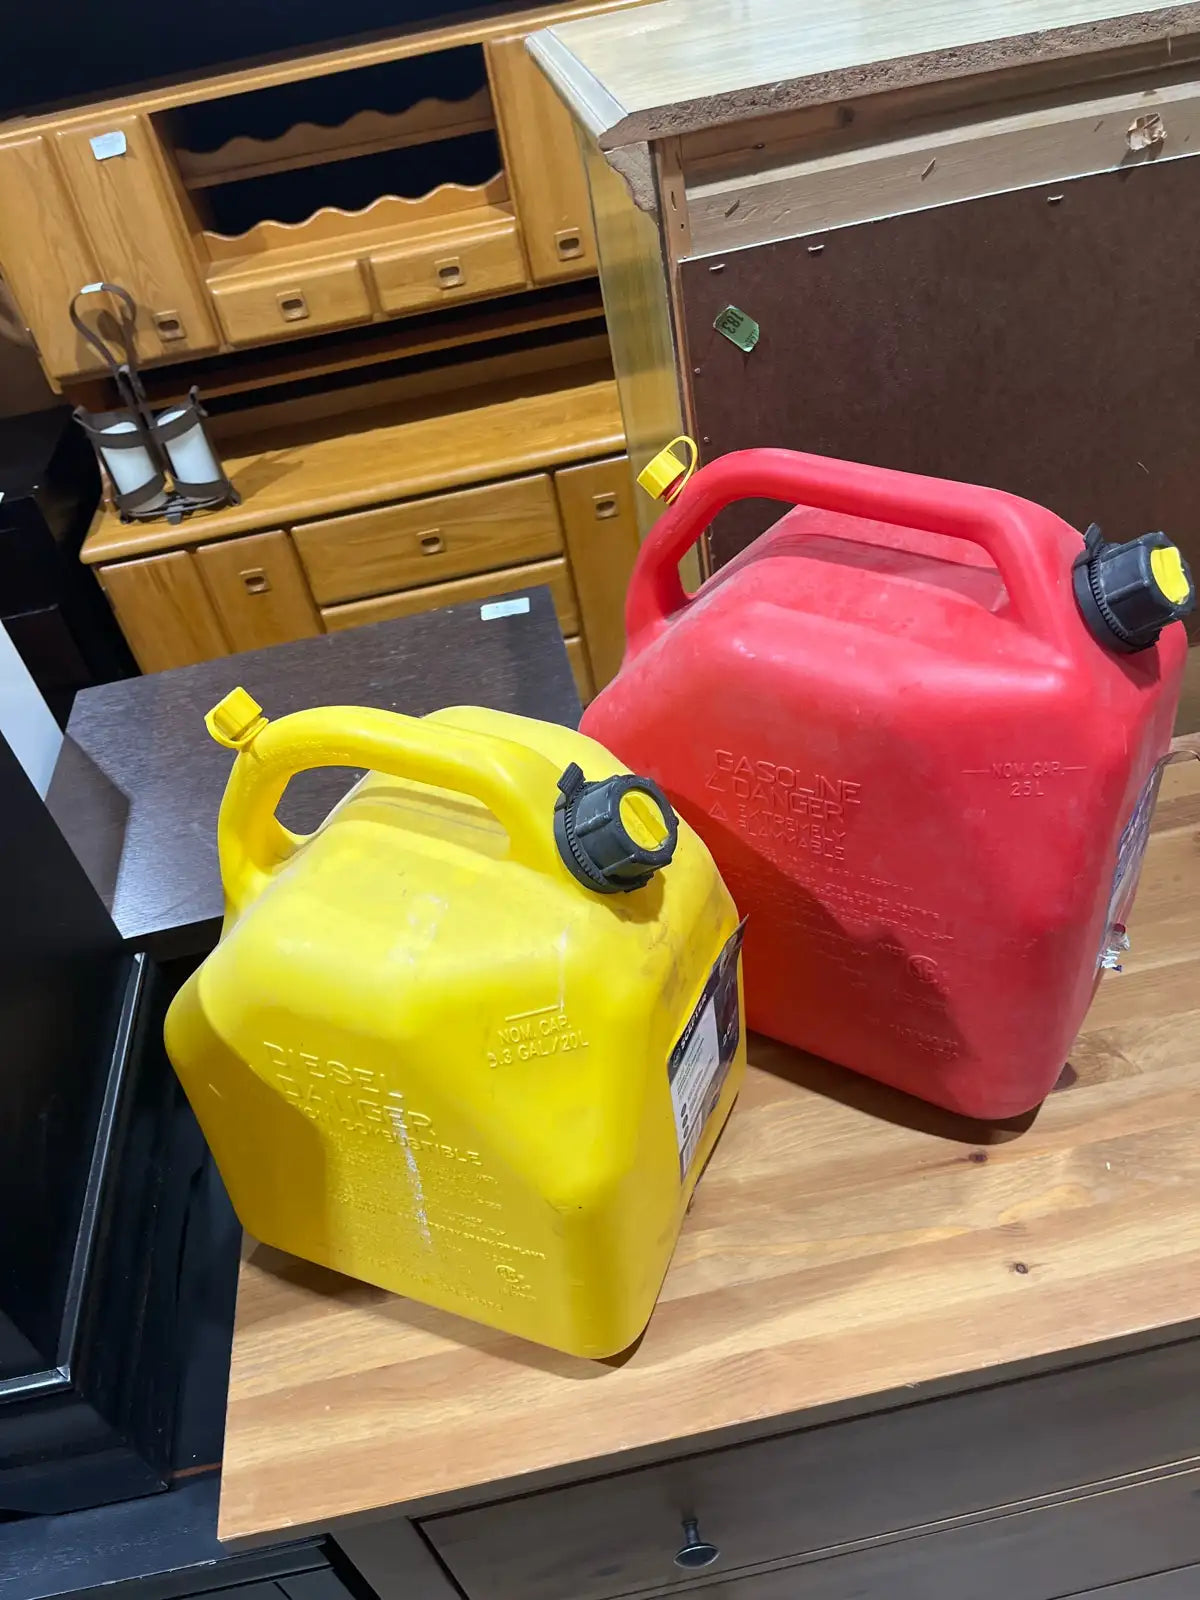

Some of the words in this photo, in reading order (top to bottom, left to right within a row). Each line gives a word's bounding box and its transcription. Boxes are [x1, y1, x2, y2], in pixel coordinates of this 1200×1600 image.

[721, 310, 744, 334] 183
[714, 748, 862, 804] GASOLINE
[731, 776, 844, 824] DANGER
[737, 803, 847, 843] EXTREMELY
[737, 819, 845, 861] FLAMMABLE
[263, 1040, 404, 1099] DIESEL
[276, 1073, 436, 1137] DANGER
[339, 1117, 483, 1166] COMBUSTIBLE
